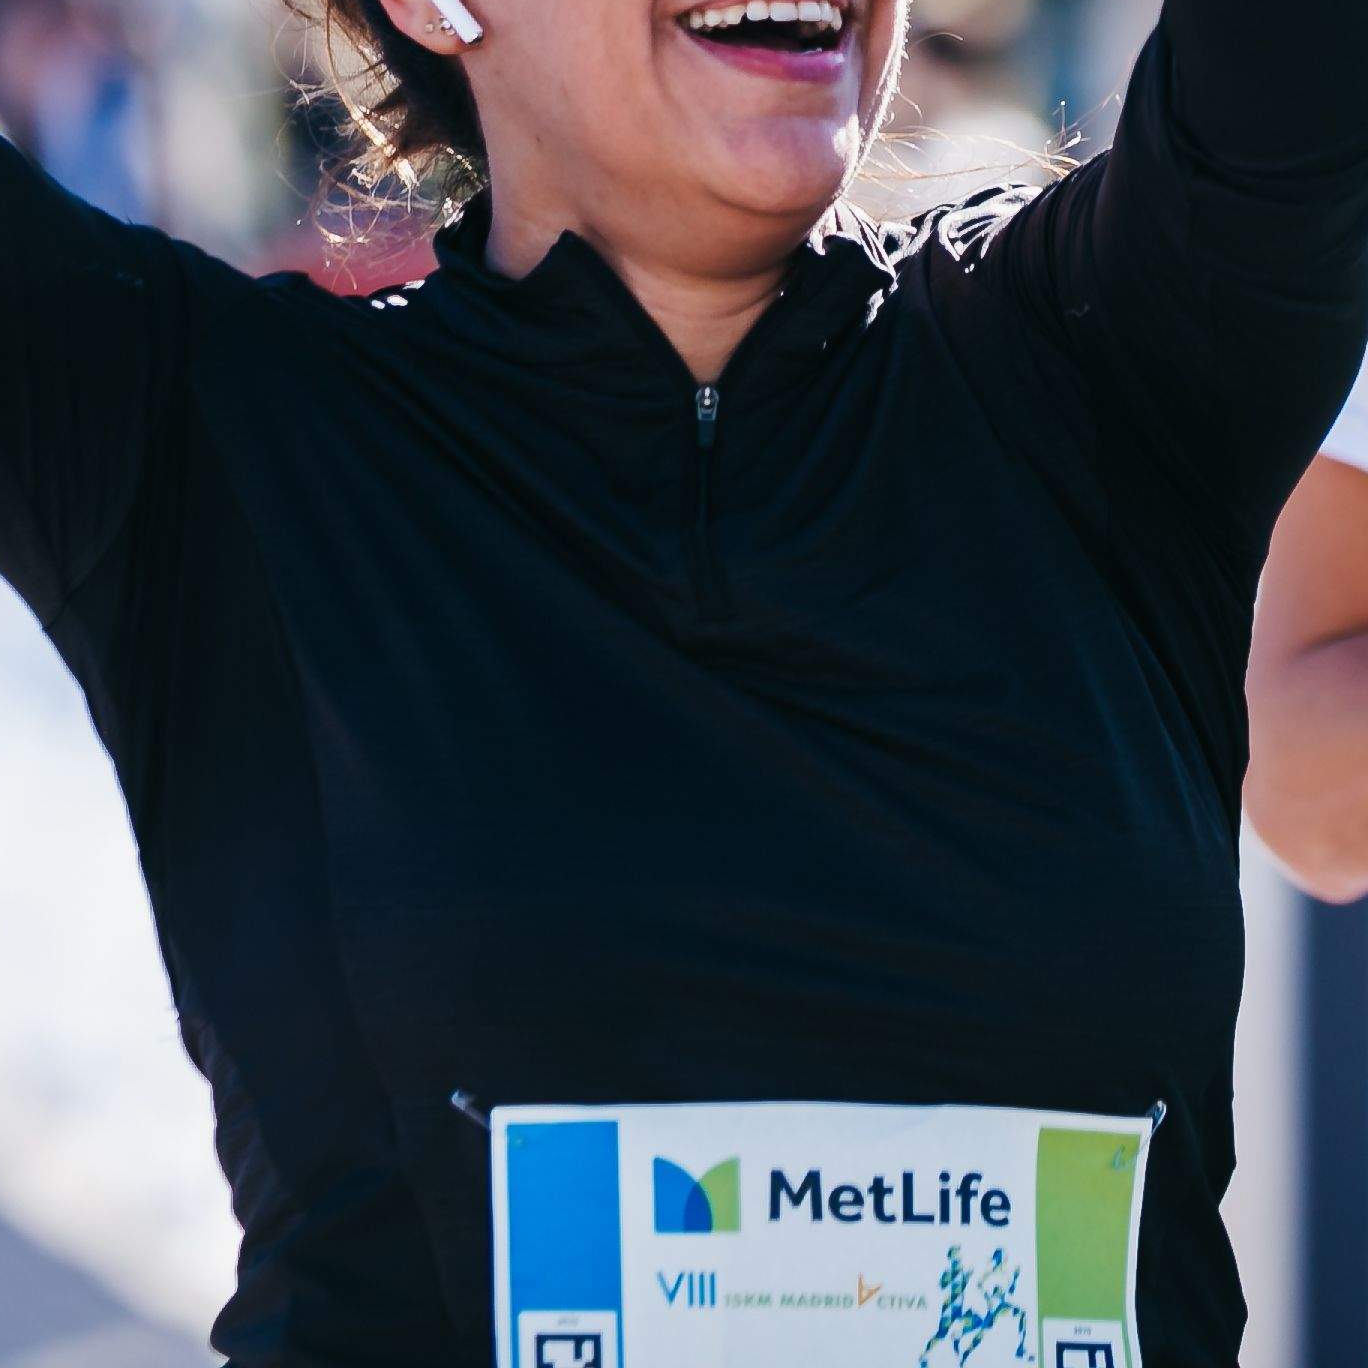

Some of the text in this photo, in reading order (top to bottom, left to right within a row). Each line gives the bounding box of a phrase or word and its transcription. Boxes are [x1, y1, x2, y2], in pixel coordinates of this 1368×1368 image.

[768, 1168, 1012, 1227] MetLife
[656, 1270, 717, 1309] VIII
[724, 1294, 773, 1309] 15KM
[779, 1293, 854, 1309] MADRID
